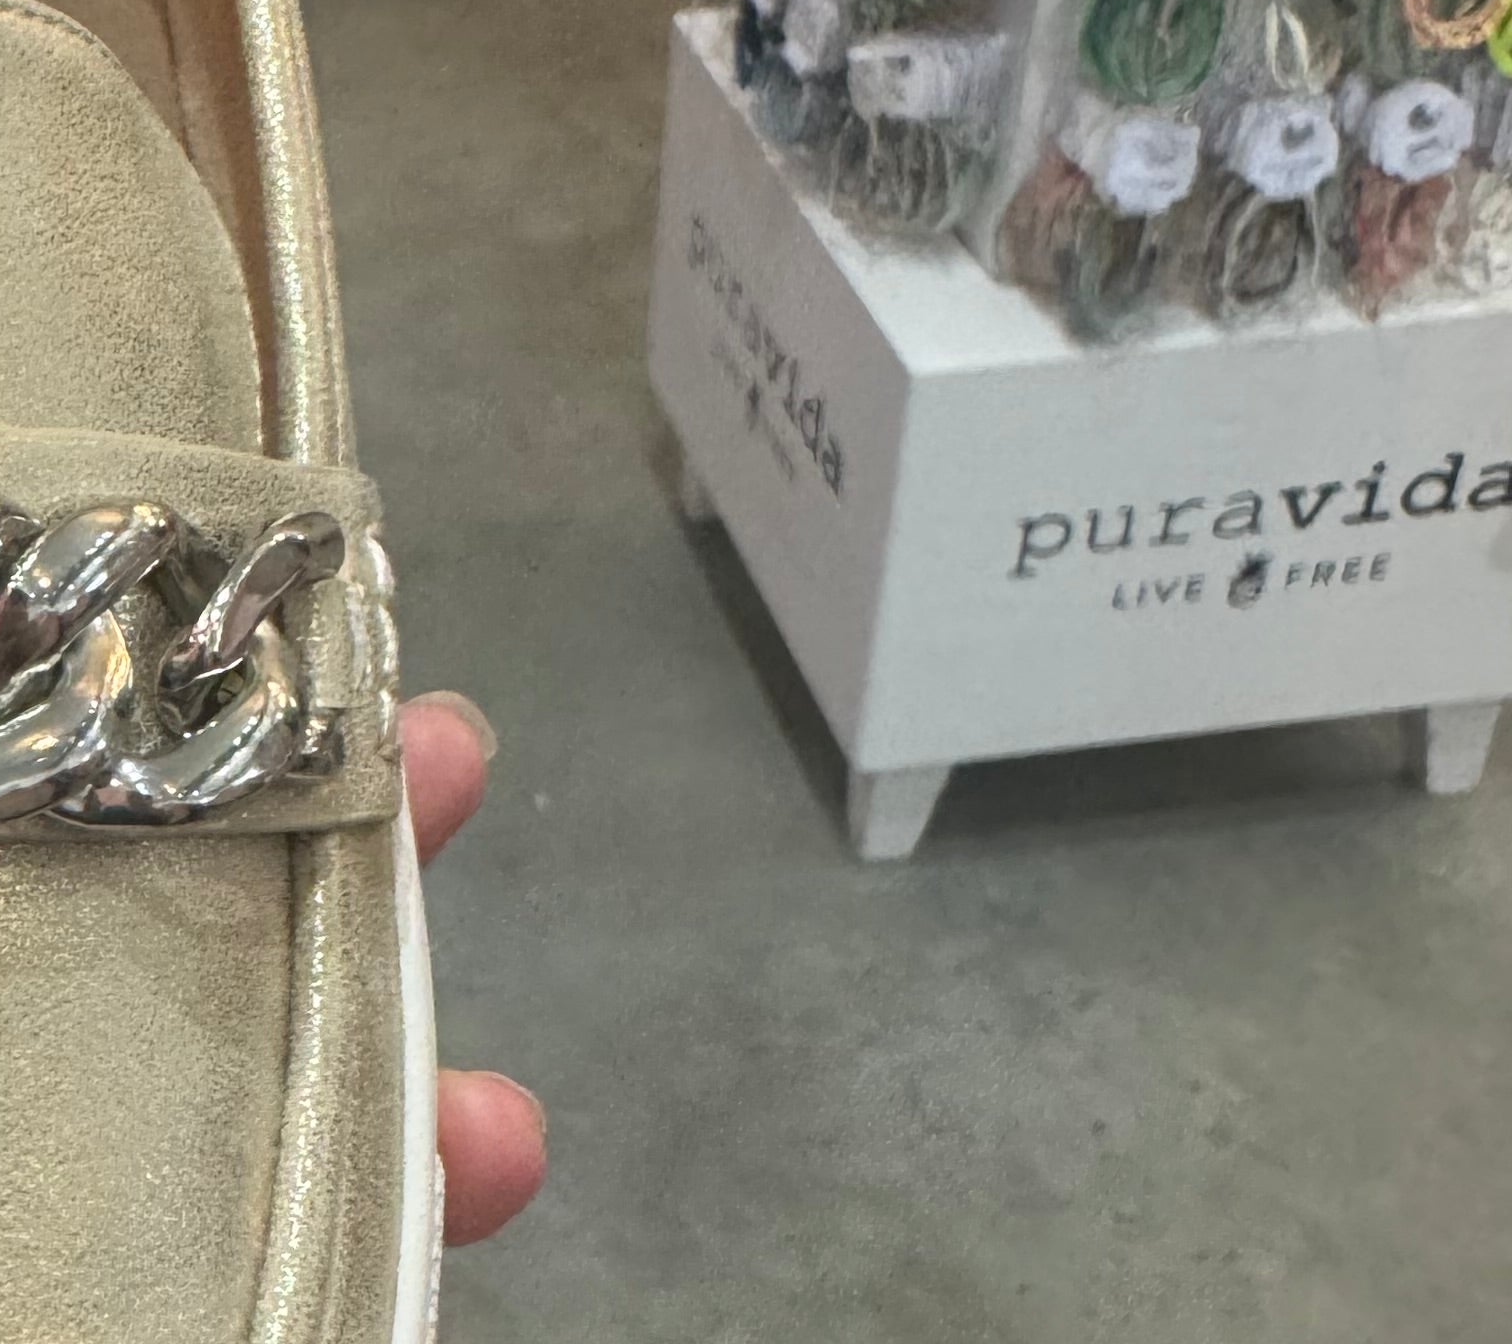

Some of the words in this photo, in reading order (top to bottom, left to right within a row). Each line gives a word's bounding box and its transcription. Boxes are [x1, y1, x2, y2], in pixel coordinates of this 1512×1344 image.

[1008, 452, 1512, 580] puravida
[1111, 573, 1205, 611] LIVE
[1284, 553, 1392, 592] FREE
